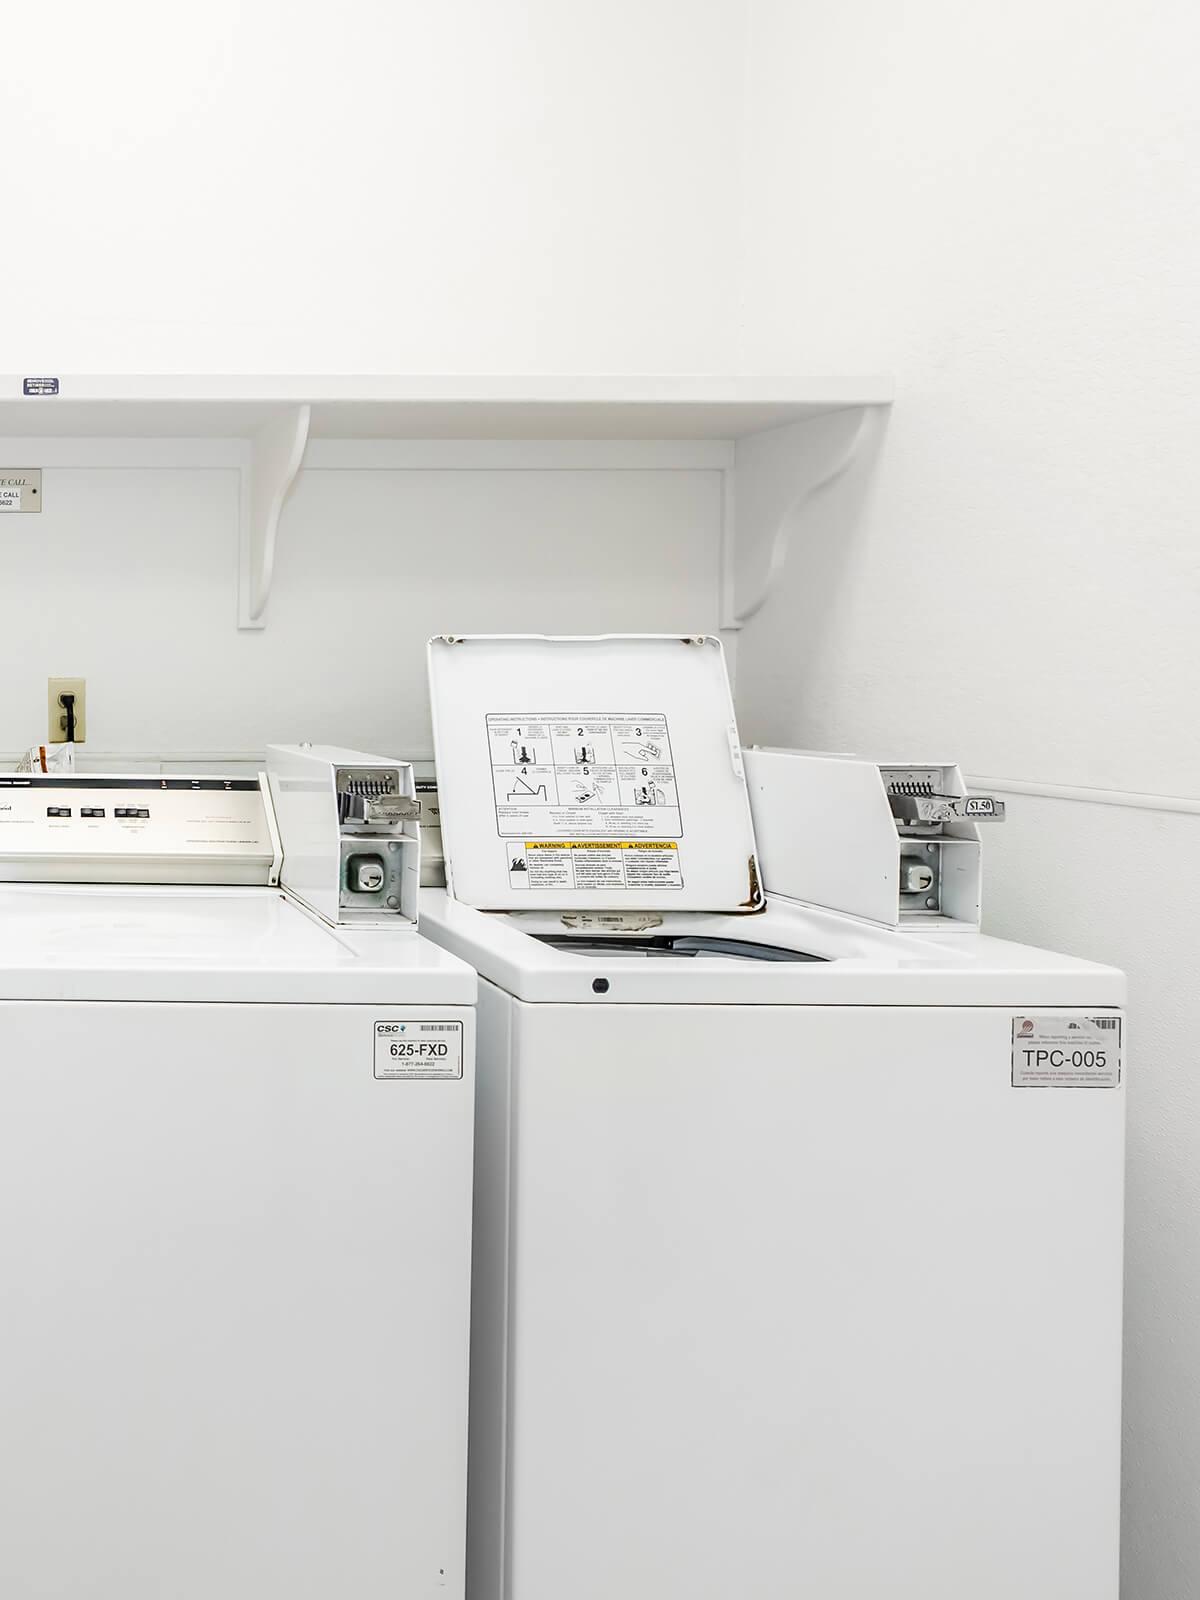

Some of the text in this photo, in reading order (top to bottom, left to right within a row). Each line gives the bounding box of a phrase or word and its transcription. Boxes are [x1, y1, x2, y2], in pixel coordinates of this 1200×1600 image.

[517, 728, 521, 736] 1
[577, 728, 584, 736] 2
[636, 728, 642, 736] 3
[521, 767, 527, 775] 4
[583, 767, 589, 775] 5
[642, 768, 648, 776] 6
[969, 801, 990, 810] $1.50
[390, 1044, 447, 1056] 625-FXD
[1022, 1050, 1106, 1067] TPC-005
